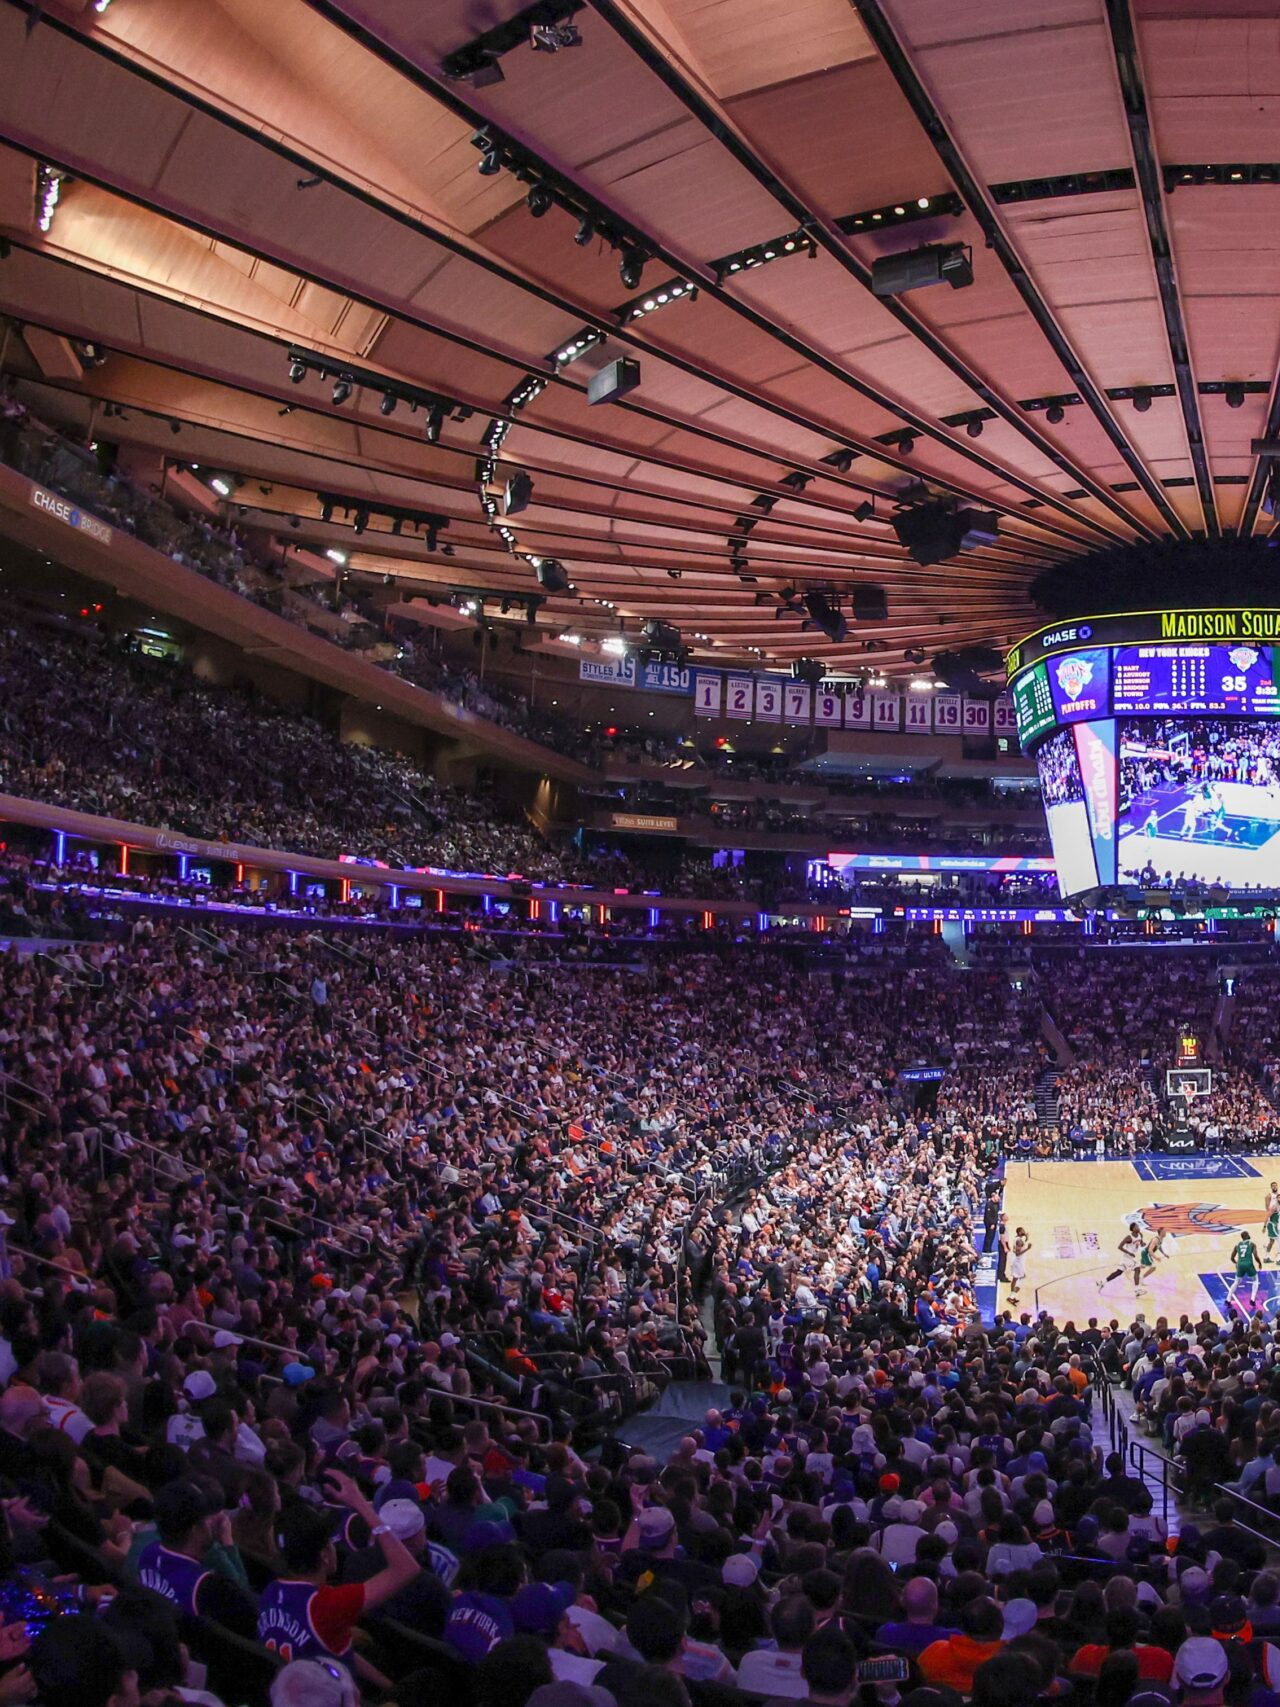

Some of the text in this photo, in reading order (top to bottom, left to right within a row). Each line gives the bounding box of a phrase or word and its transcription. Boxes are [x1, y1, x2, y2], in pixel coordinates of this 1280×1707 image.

[34, 491, 70, 520] CHASE
[1161, 613, 1236, 637] MADISON
[1042, 628, 1077, 647] CHASE
[582, 657, 633, 678] STYLES 15
[662, 666, 690, 688] 150
[1221, 676, 1247, 692] 35
[1256, 686, 1278, 695] 3:32
[704, 687, 711, 706] 1
[734, 690, 745, 709] 2
[764, 693, 774, 712] 3
[792, 696, 802, 715] 7
[824, 698, 834, 716] 9
[852, 700, 864, 719] 9
[879, 702, 894, 722] 11
[910, 705, 926, 724] 11
[939, 706, 958, 724] 19
[1061, 699, 1096, 715] PLAYOFFS
[966, 708, 986, 726] 30
[996, 708, 1016, 726] 35
[1184, 1046, 1194, 1055] 16
[1170, 1140, 1194, 1148] KIA
[1240, 1249, 1246, 1258] 7
[450, 1608, 500, 1640] NEW YORK
